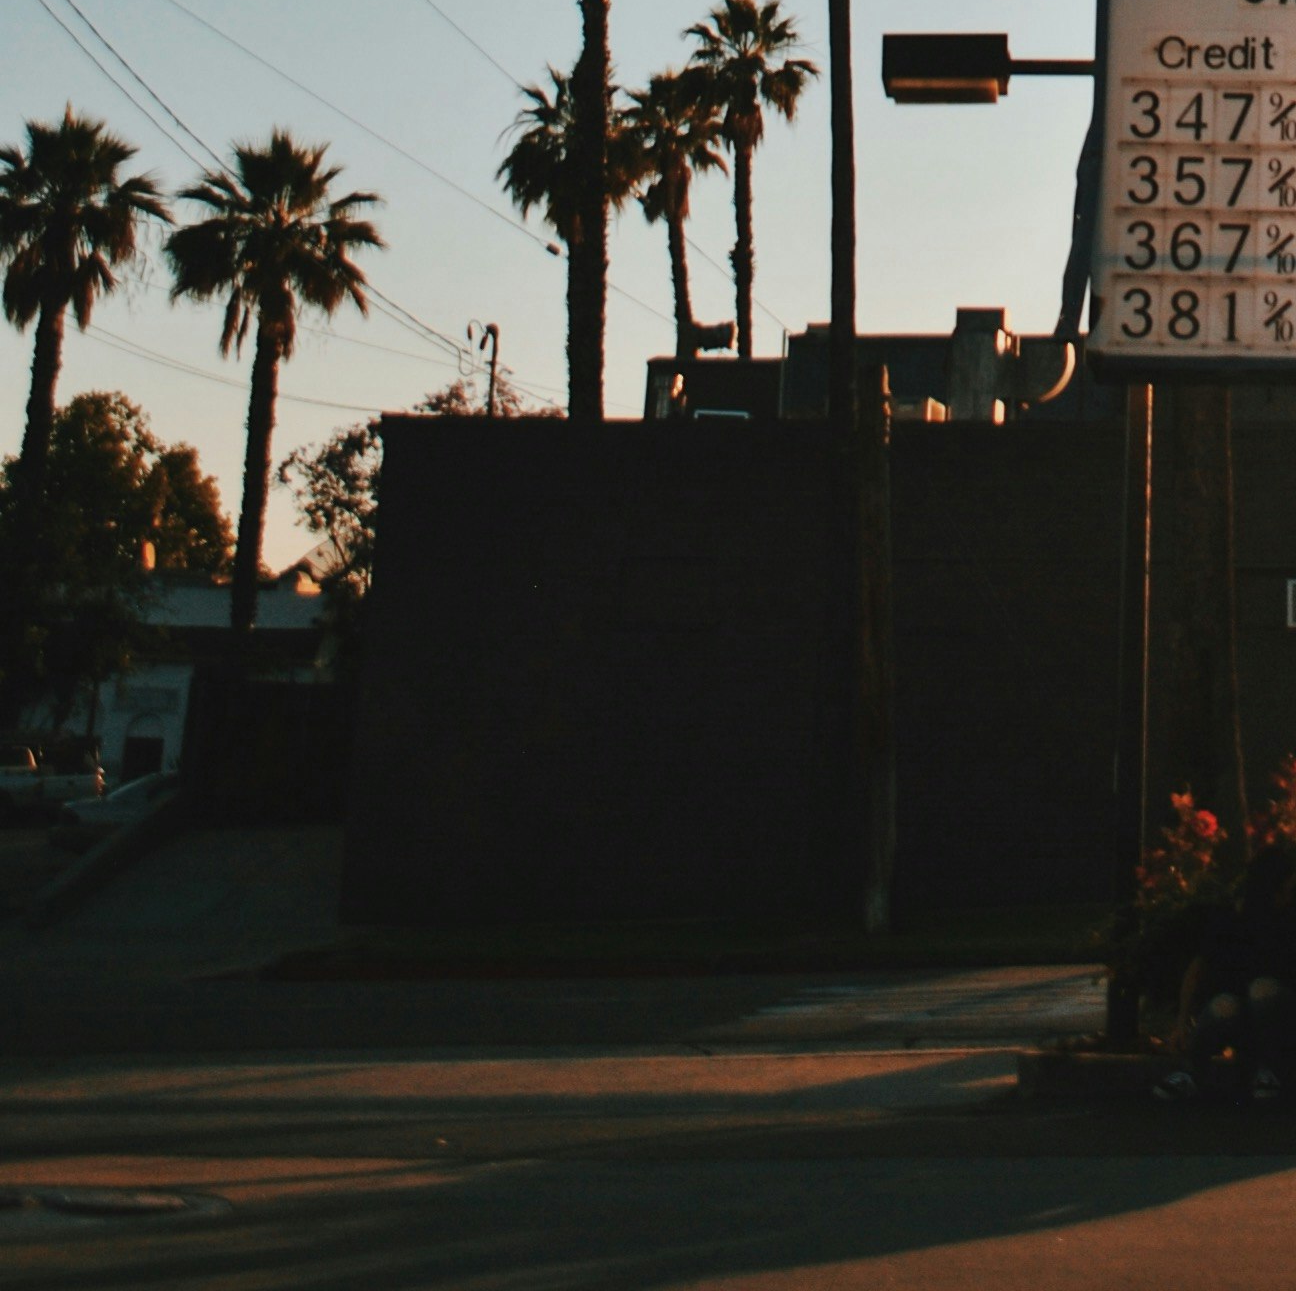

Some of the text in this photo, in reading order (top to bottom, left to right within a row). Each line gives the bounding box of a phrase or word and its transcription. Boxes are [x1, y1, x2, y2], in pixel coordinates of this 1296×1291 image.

[1156, 35, 1275, 70] Credit
[1129, 89, 1254, 142] 347
[1127, 155, 1253, 208] 357
[1124, 220, 1251, 274] 367
[1120, 287, 1239, 343] 381
